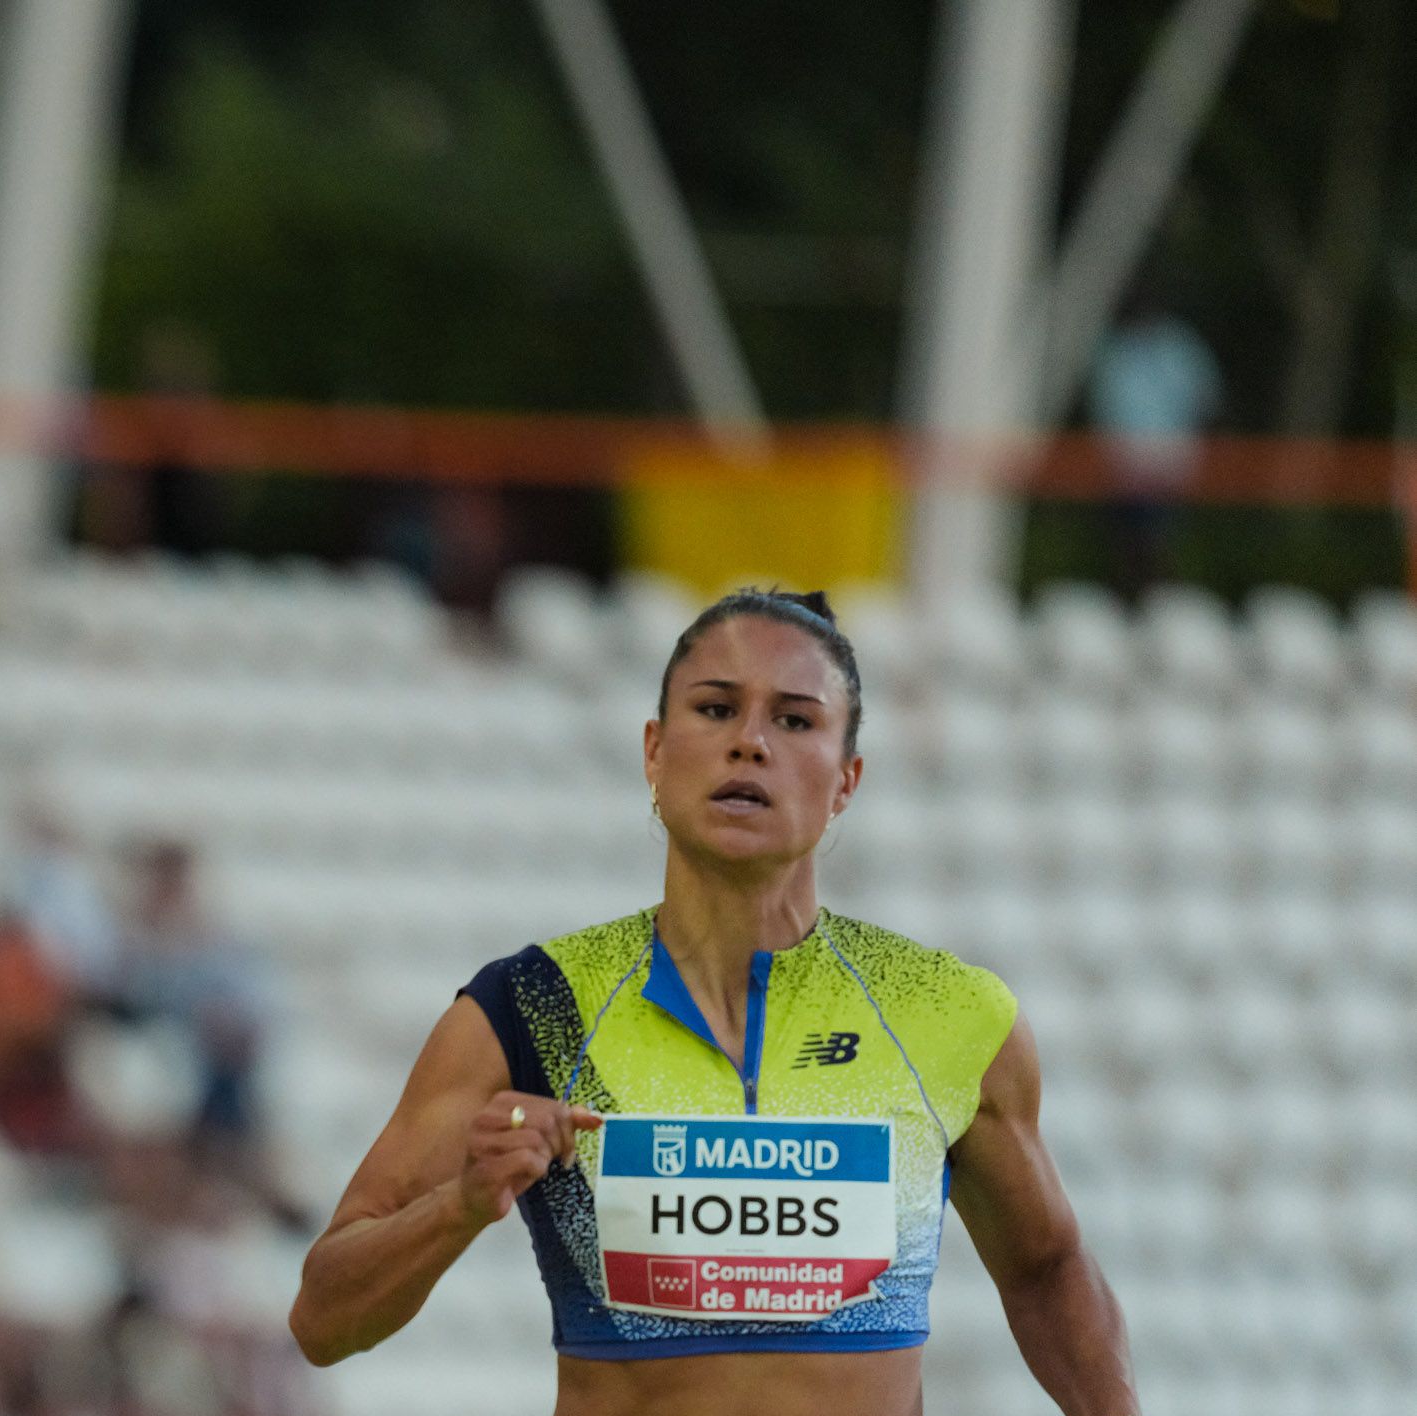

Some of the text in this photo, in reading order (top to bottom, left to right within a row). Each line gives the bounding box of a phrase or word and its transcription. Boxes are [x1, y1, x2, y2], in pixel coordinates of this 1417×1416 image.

[695, 1137, 840, 1177] MADRID
[652, 1194, 840, 1237] HOBBS
[700, 1260, 844, 1284] Comunidad
[700, 1287, 843, 1311] de Madrid
